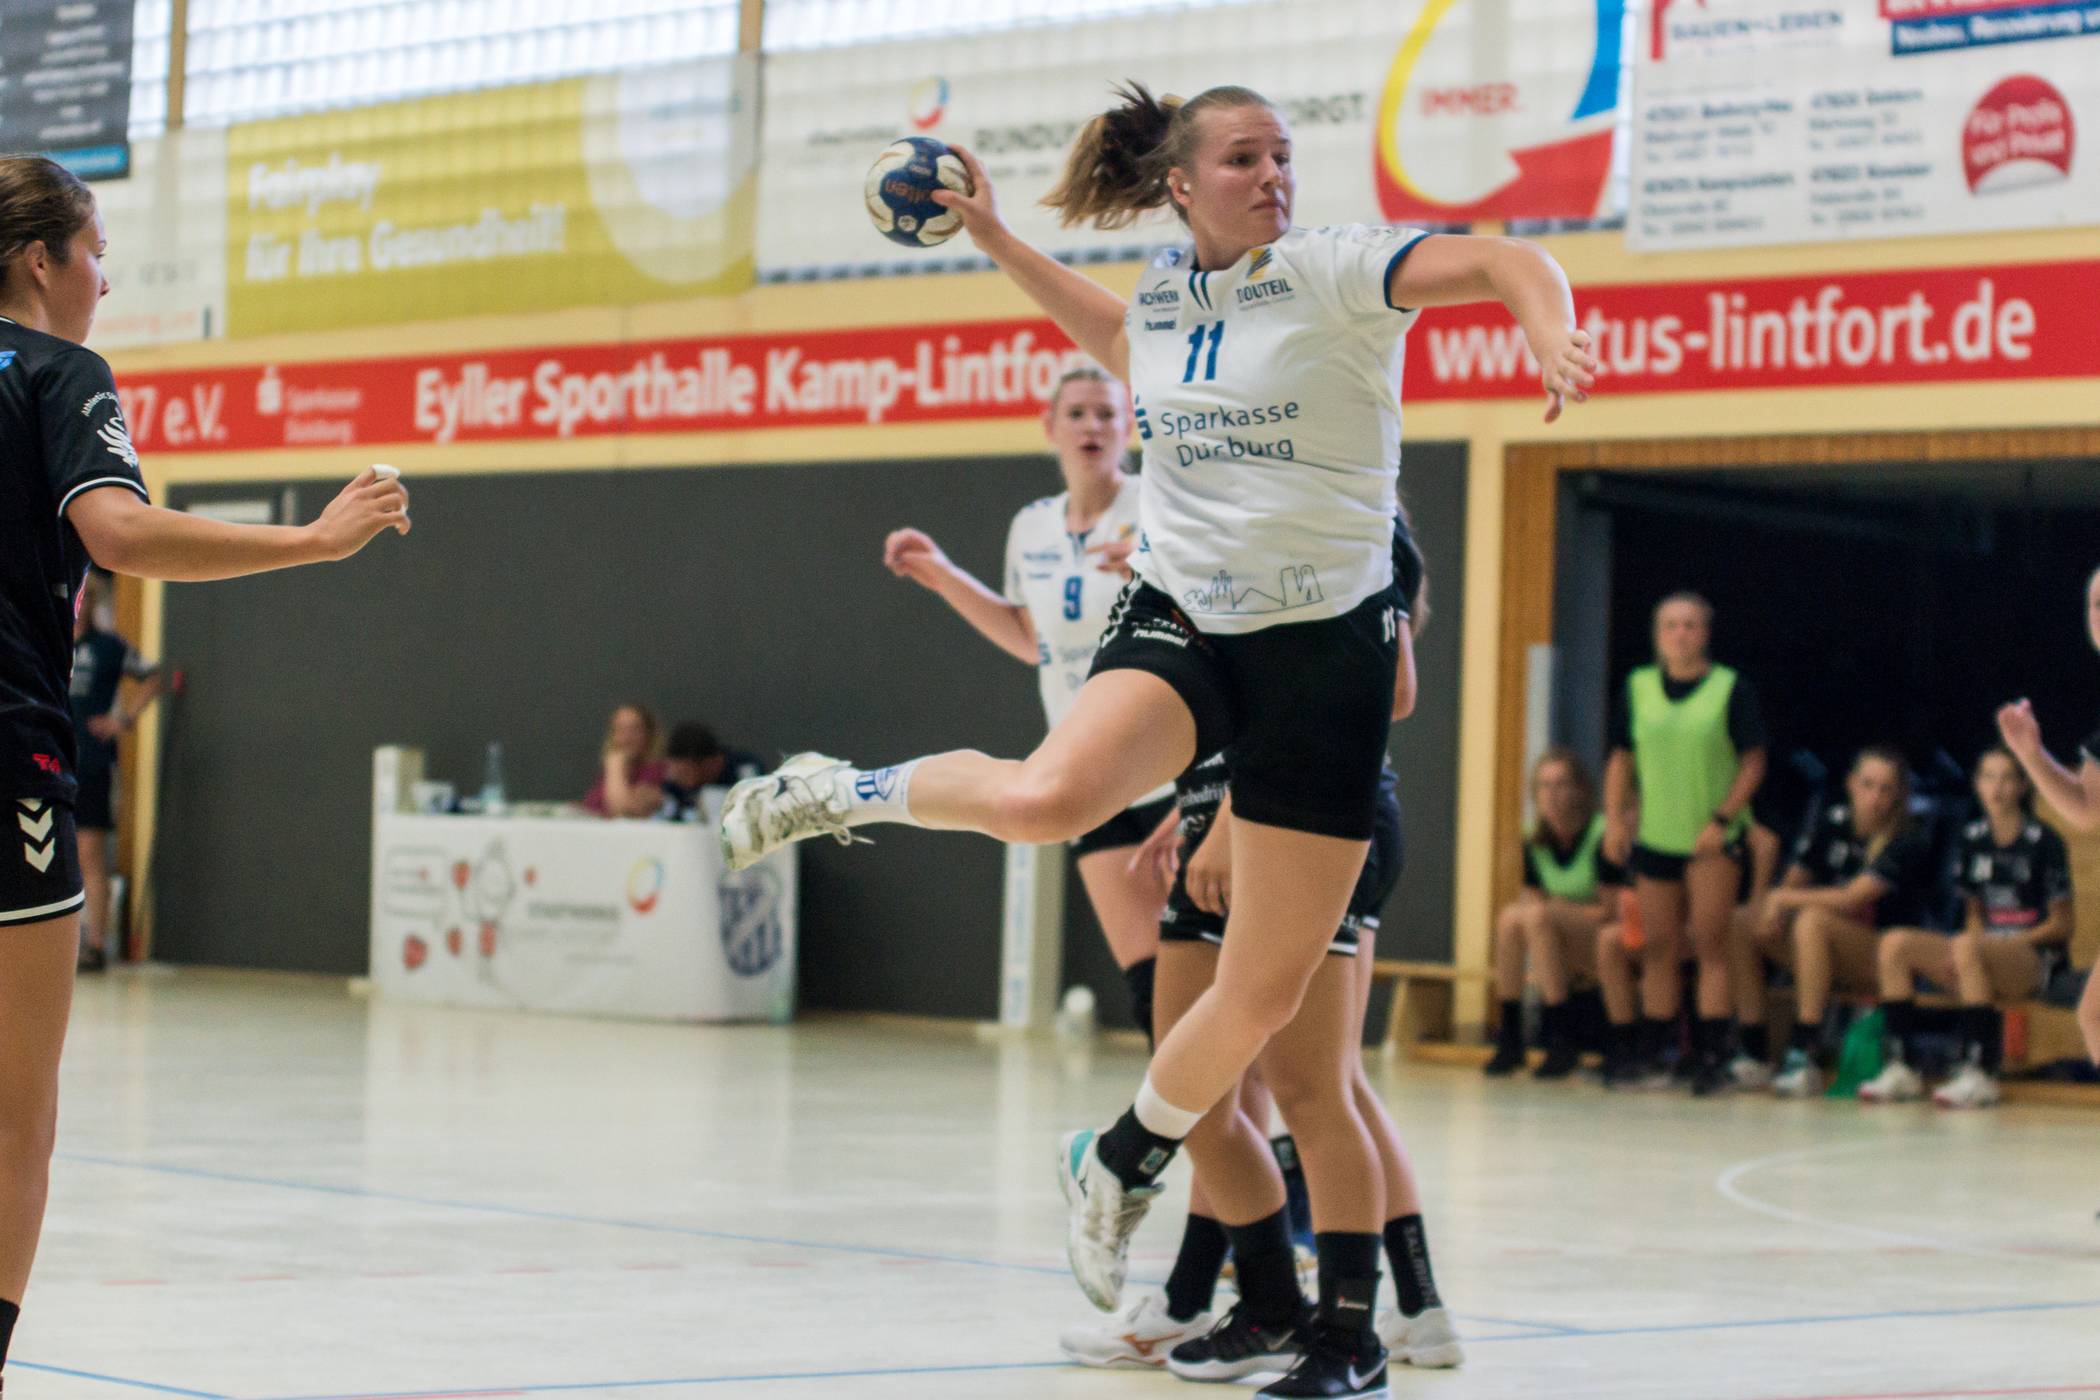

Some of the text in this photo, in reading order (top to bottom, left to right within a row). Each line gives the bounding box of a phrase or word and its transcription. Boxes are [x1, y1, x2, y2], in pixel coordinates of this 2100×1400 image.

[1182, 319, 1225, 383] 11
[162, 380, 228, 446] e.V.
[413, 361, 528, 445] Eyller
[530, 346, 758, 439] Sporthalle
[1160, 401, 1300, 439] Sparkasse
[1063, 575, 1083, 622] 9
